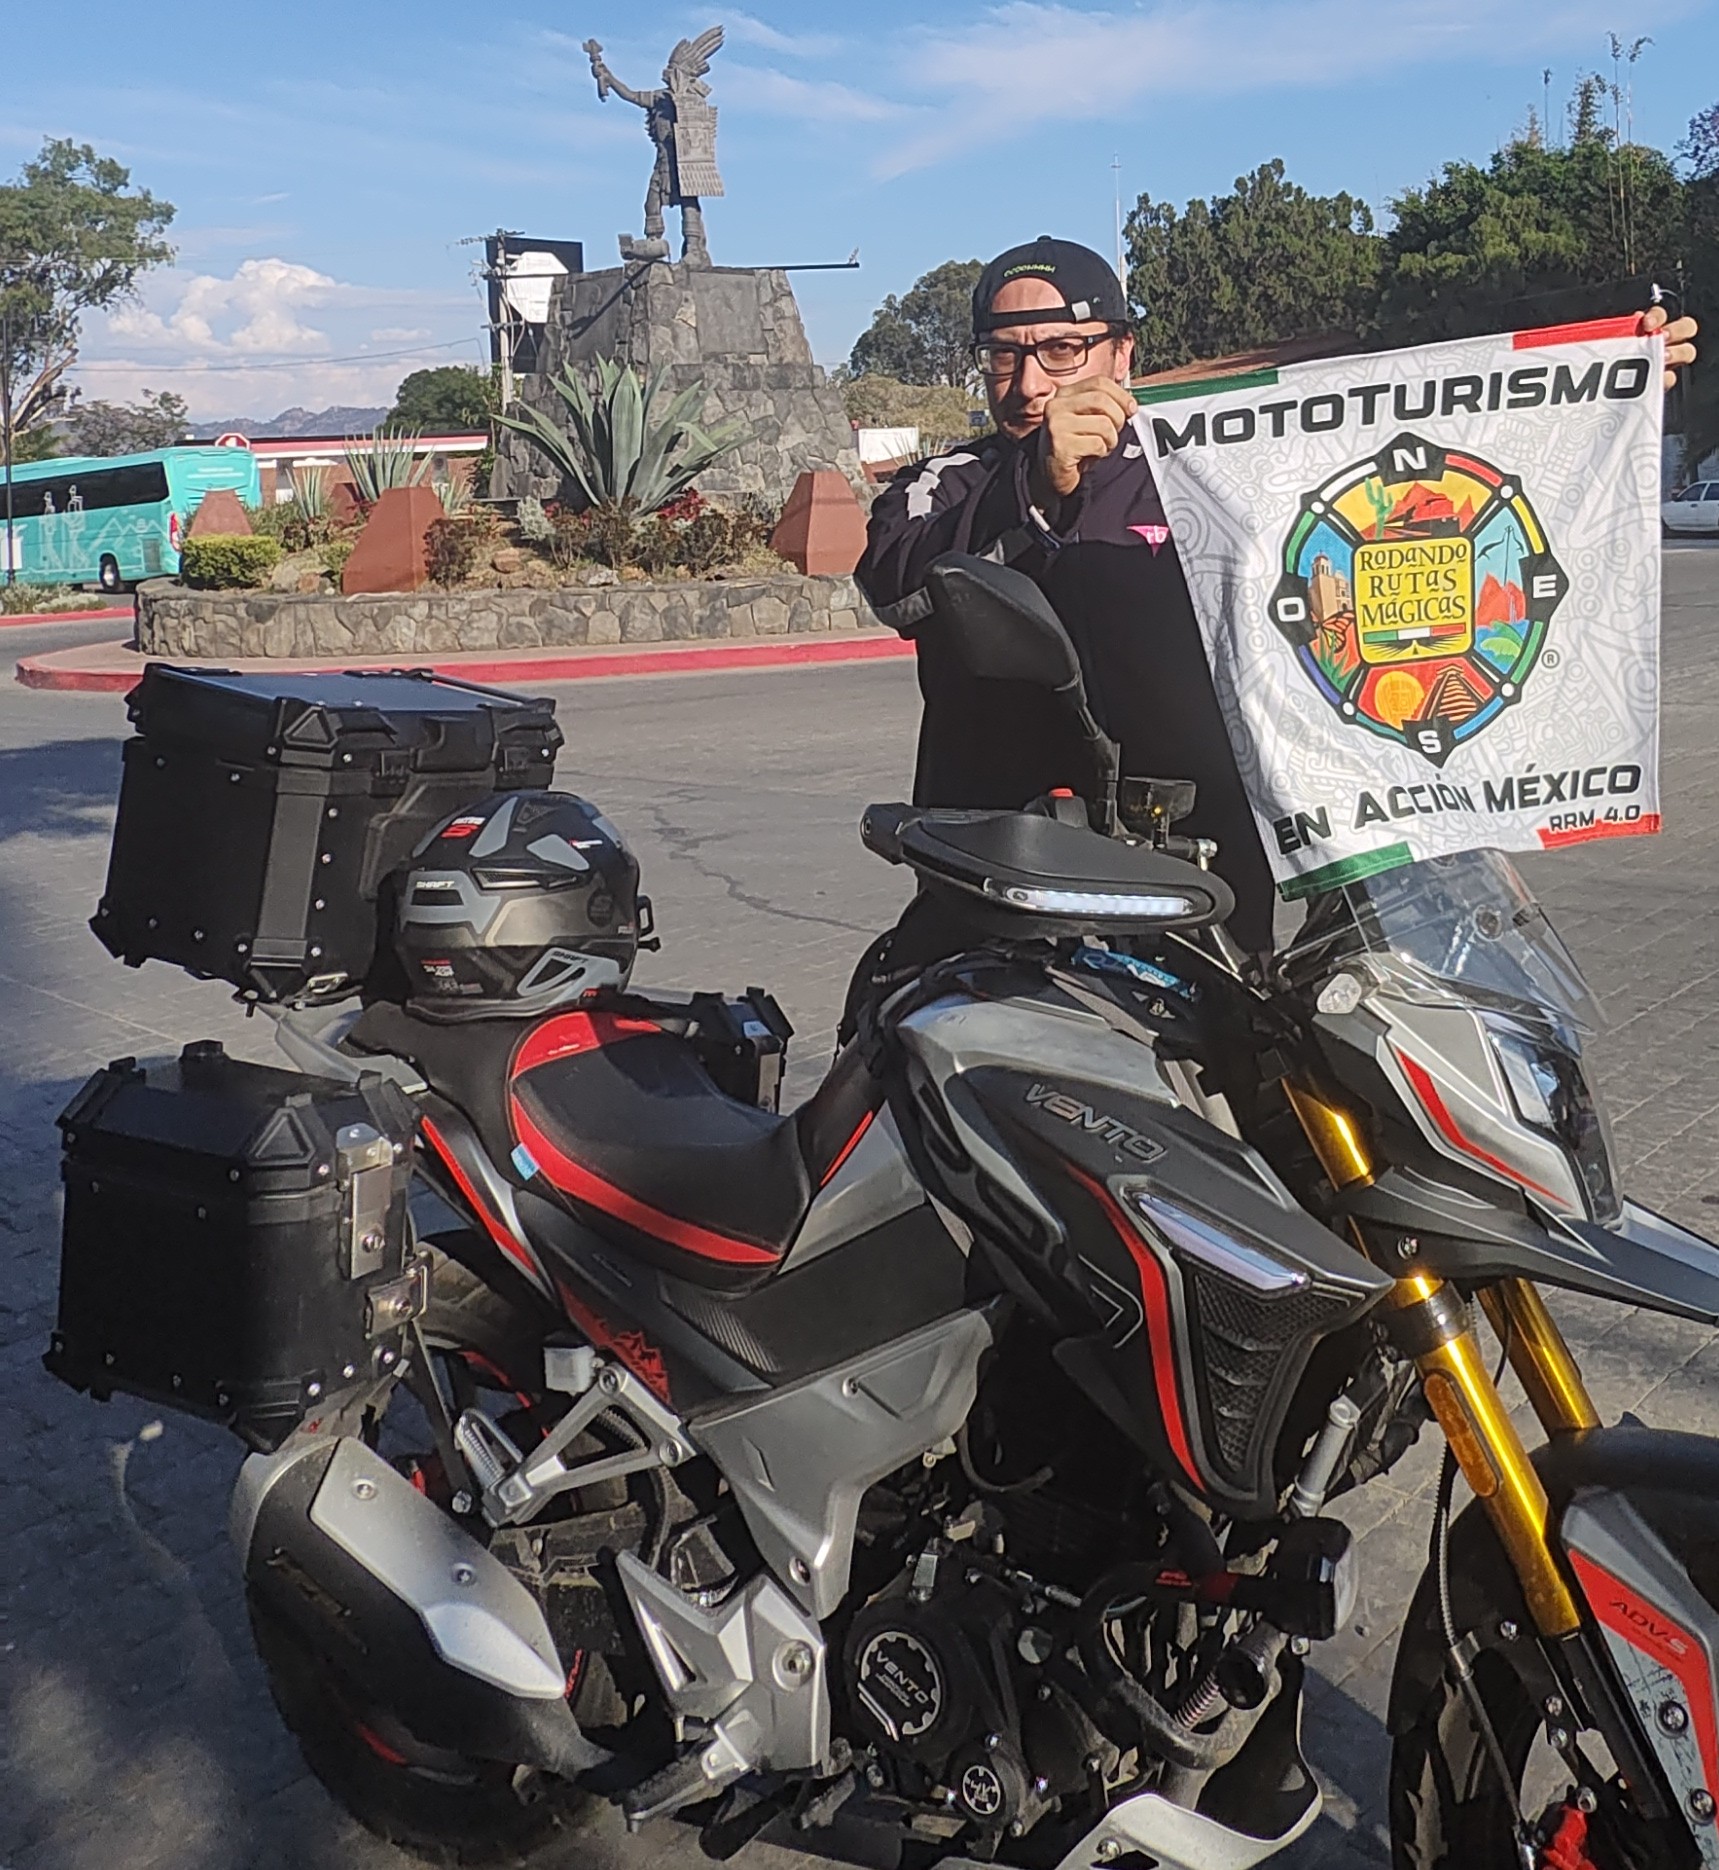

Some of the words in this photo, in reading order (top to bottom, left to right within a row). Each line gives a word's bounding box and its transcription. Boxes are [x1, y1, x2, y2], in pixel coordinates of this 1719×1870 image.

[1152, 357, 1650, 458] MOTOTURISMO
[1393, 446, 1427, 472] N
[1533, 574, 1557, 599] E
[1276, 597, 1306, 623] O
[1417, 730, 1442, 754] S
[1273, 806, 1332, 855] EN
[1354, 773, 1477, 829] ACCIÓN
[1482, 763, 1642, 813] MÉXICO
[1550, 809, 1595, 831] RRM
[1604, 805, 1640, 822] 4.0
[1025, 1083, 1166, 1160] VENTO
[876, 1650, 930, 1704] VENTO
